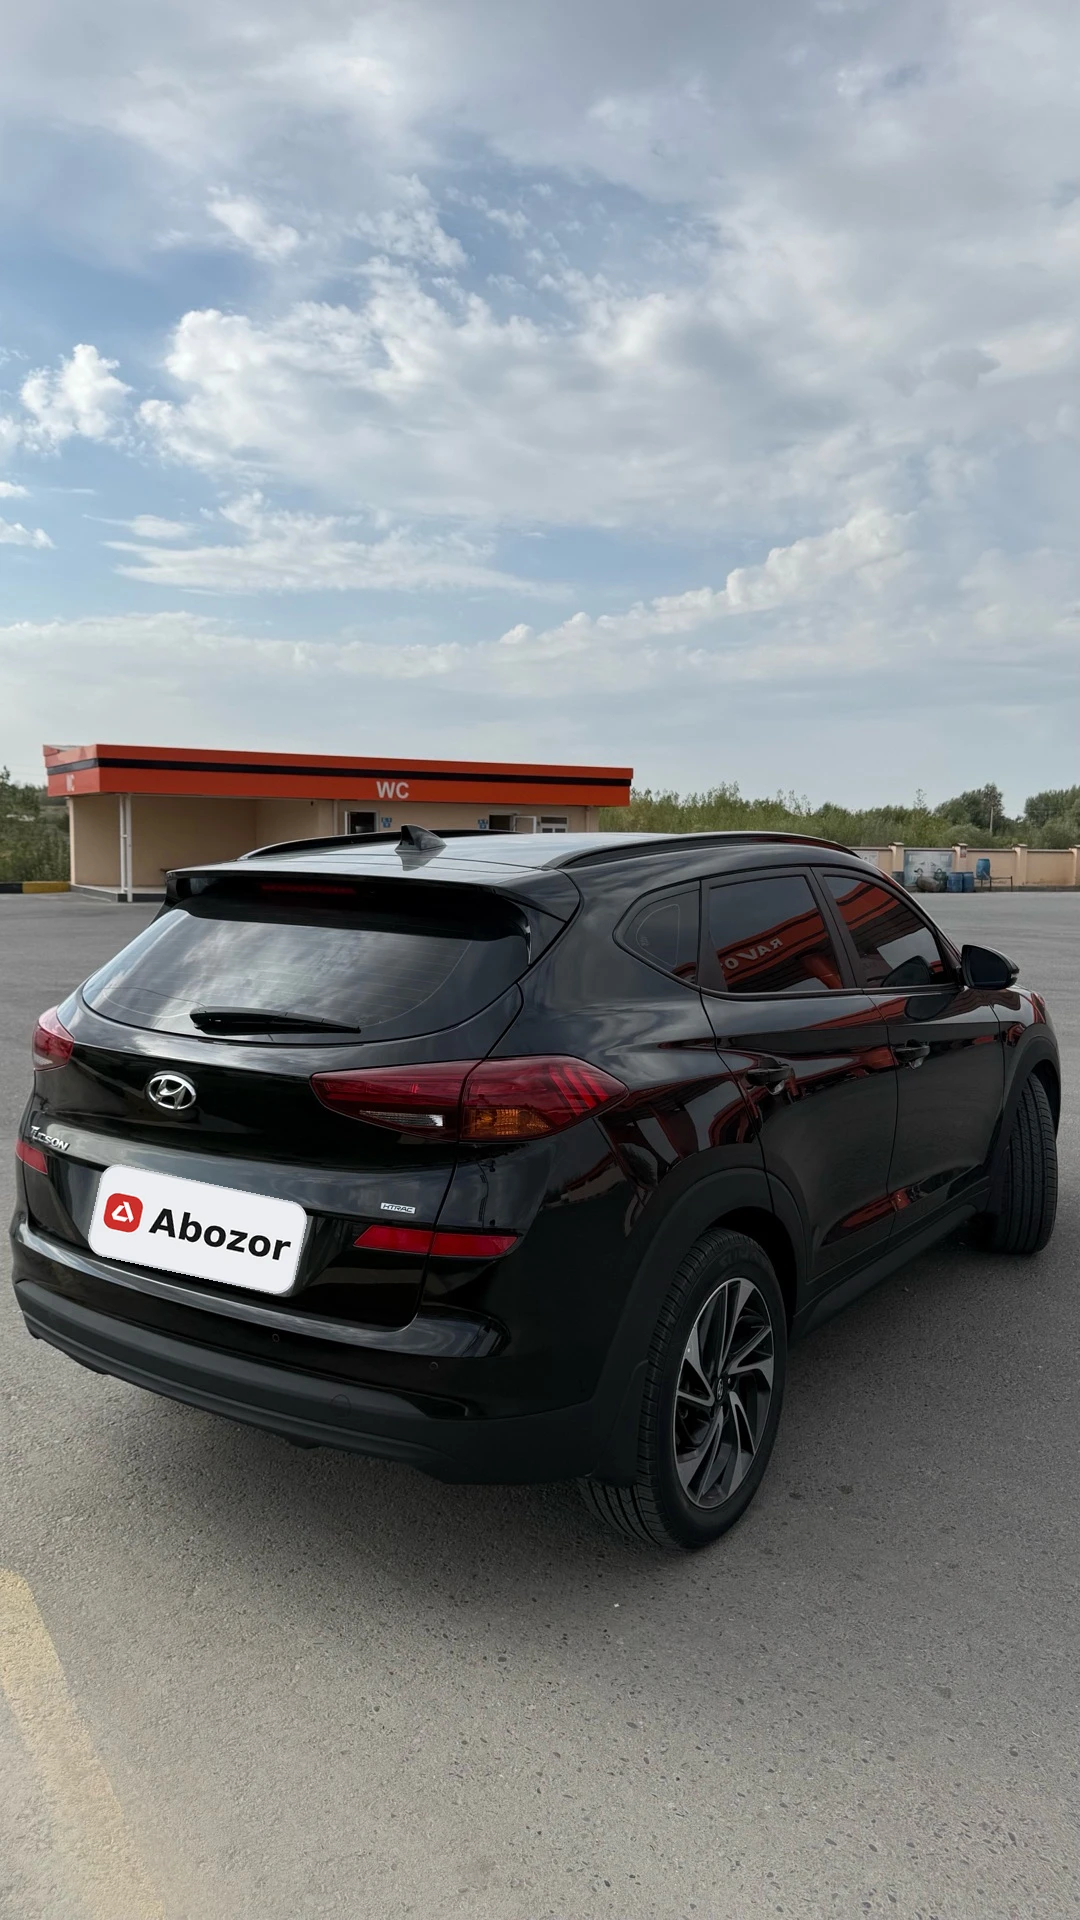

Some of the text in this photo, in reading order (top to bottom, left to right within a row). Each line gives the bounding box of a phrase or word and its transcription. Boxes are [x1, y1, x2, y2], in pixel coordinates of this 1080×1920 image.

[376, 781, 409, 799] WC
[31, 1125, 70, 1151] TUCSON
[382, 1203, 415, 1213] HTRAC
